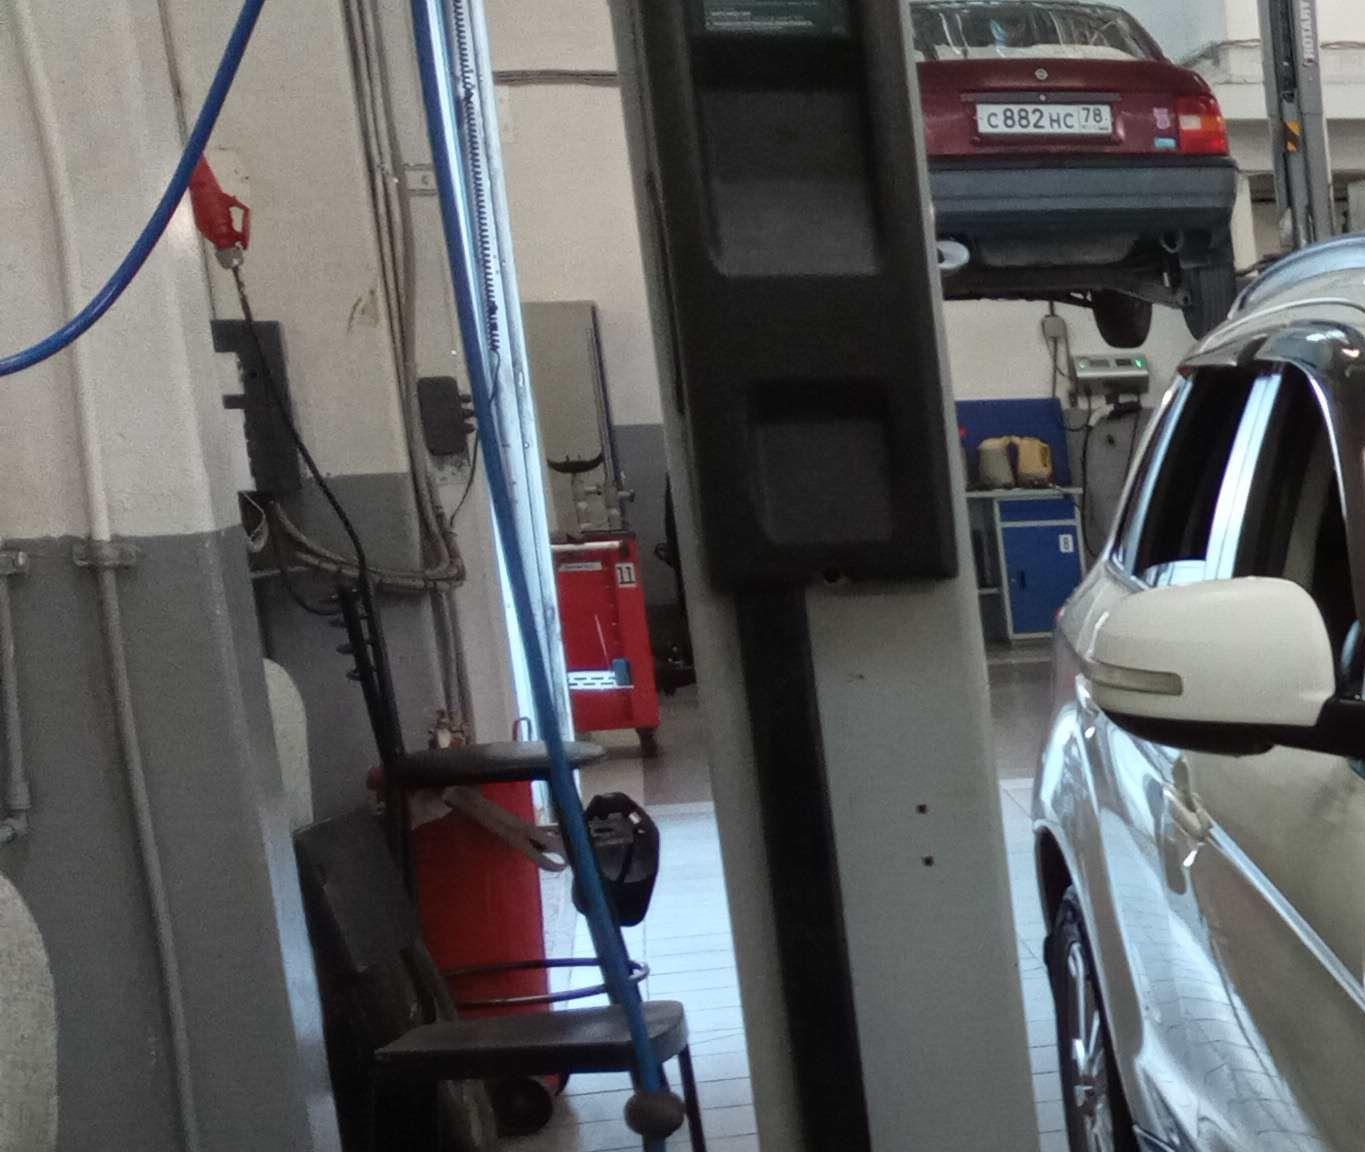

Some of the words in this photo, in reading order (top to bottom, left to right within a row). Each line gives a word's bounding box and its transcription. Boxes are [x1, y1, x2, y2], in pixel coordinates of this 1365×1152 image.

[1300, 0, 1314, 58] ROTARY
[987, 107, 1075, 129] С882НС
[1081, 106, 1103, 124] 78
[617, 566, 636, 585] 11
